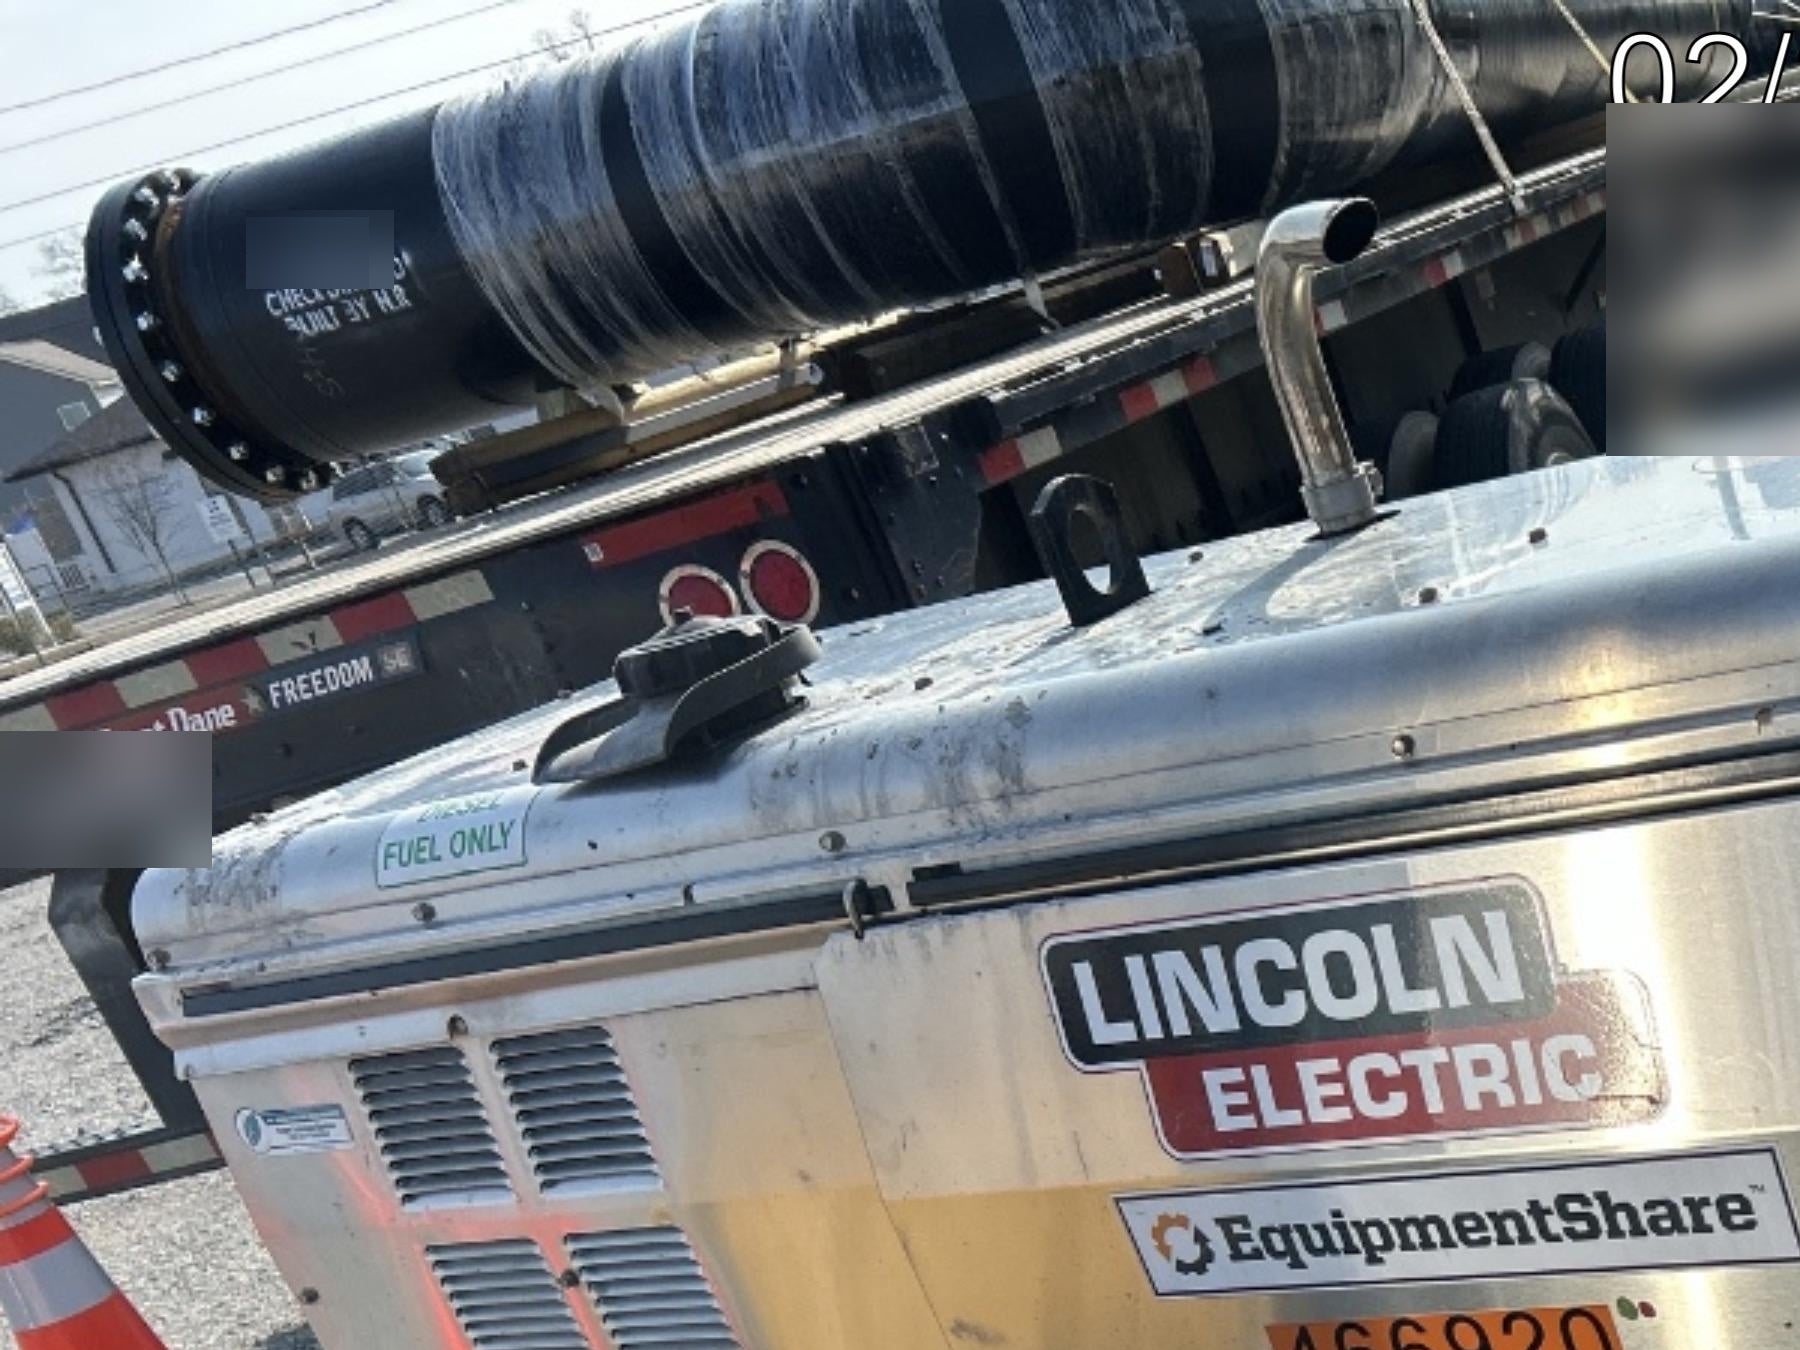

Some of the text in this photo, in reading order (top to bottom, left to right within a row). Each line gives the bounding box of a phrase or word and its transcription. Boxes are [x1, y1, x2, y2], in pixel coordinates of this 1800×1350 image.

[268, 655, 374, 709] FREEDOM
[167, 704, 237, 731] Dane
[383, 818, 516, 871] FUEL ONLY
[1071, 910, 1524, 1045] LINCOLN
[1202, 1034, 1605, 1132] ELECTRIC
